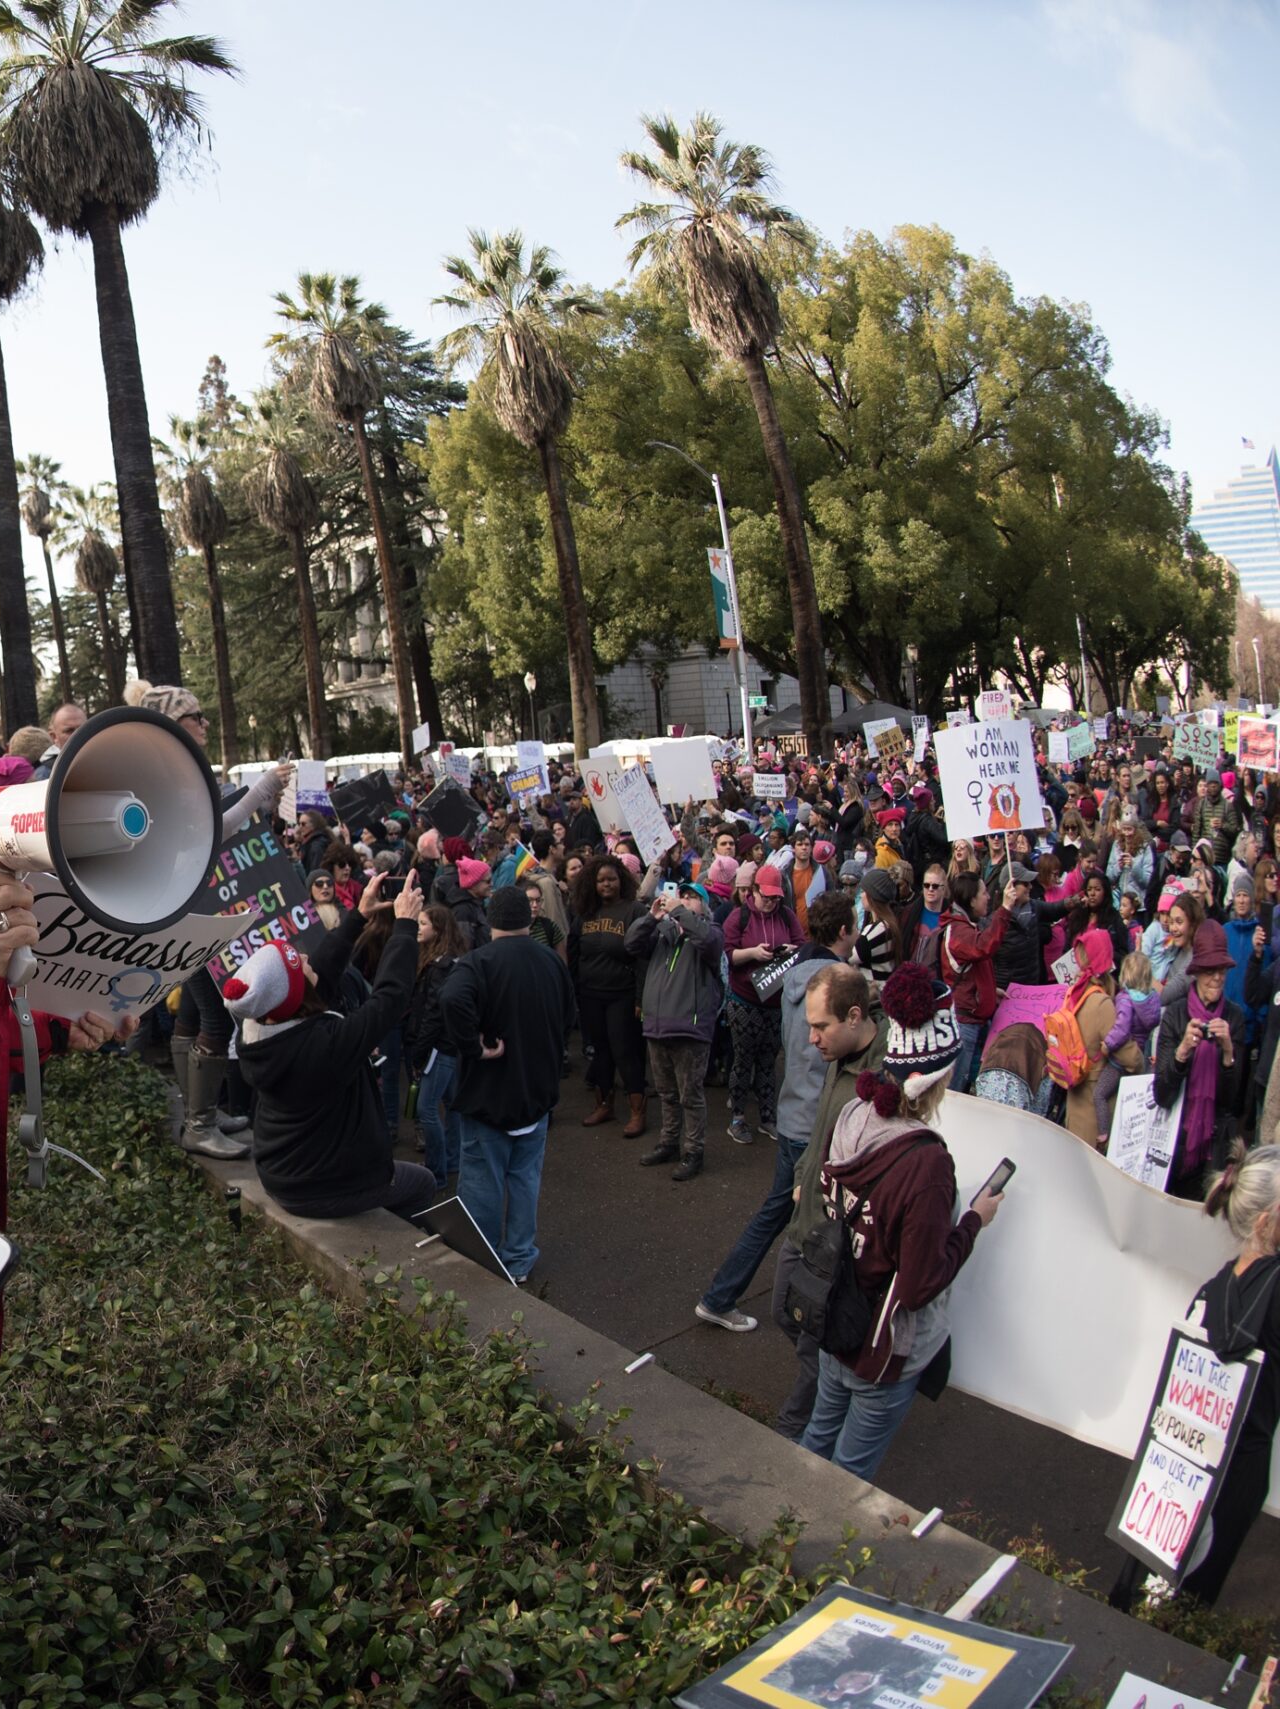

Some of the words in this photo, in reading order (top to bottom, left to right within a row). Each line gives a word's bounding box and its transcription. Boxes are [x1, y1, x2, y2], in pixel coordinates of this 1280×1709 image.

[982, 693, 1004, 703] FIRED
[974, 730, 978, 740] I
[985, 727, 1003, 740] AM
[778, 735, 809, 756] RESIST
[879, 740, 904, 757] NASTY
[965, 741, 1020, 759] WOMAN
[507, 773, 525, 782] CARE
[525, 767, 540, 776] NOT
[979, 762, 1007, 778] HEAR
[1009, 761, 1020, 774] ME
[511, 774, 541, 792] CHAOS
[614, 765, 643, 796] EQUALITY
[11, 811, 47, 833] GOPHE
[208, 832, 279, 887] ENCE
[219, 879, 238, 902] or
[213, 882, 286, 920] PECT
[207, 898, 320, 981] RESISTENCE
[32, 958, 120, 995] STARTS
[757, 951, 801, 990] EALTH4ALL
[1009, 987, 1049, 1001] Queer
[1154, 1129, 1168, 1142] SAVE
[1177, 1348, 1205, 1377] MEN
[1168, 1374, 1233, 1430] WOMEN'S
[1166, 1415, 1206, 1454] POWER
[1146, 1448, 1167, 1470] AND
[1168, 1457, 1188, 1484] USE
[1188, 1473, 1204, 1492] IT
[1158, 1481, 1175, 1499] AS
[853, 1617, 888, 1634] Places
[911, 1634, 946, 1652] Wrong
[939, 1660, 955, 1672] the
[957, 1666, 976, 1678] All
[925, 1682, 938, 1691] in
[879, 1693, 907, 1708] Love
